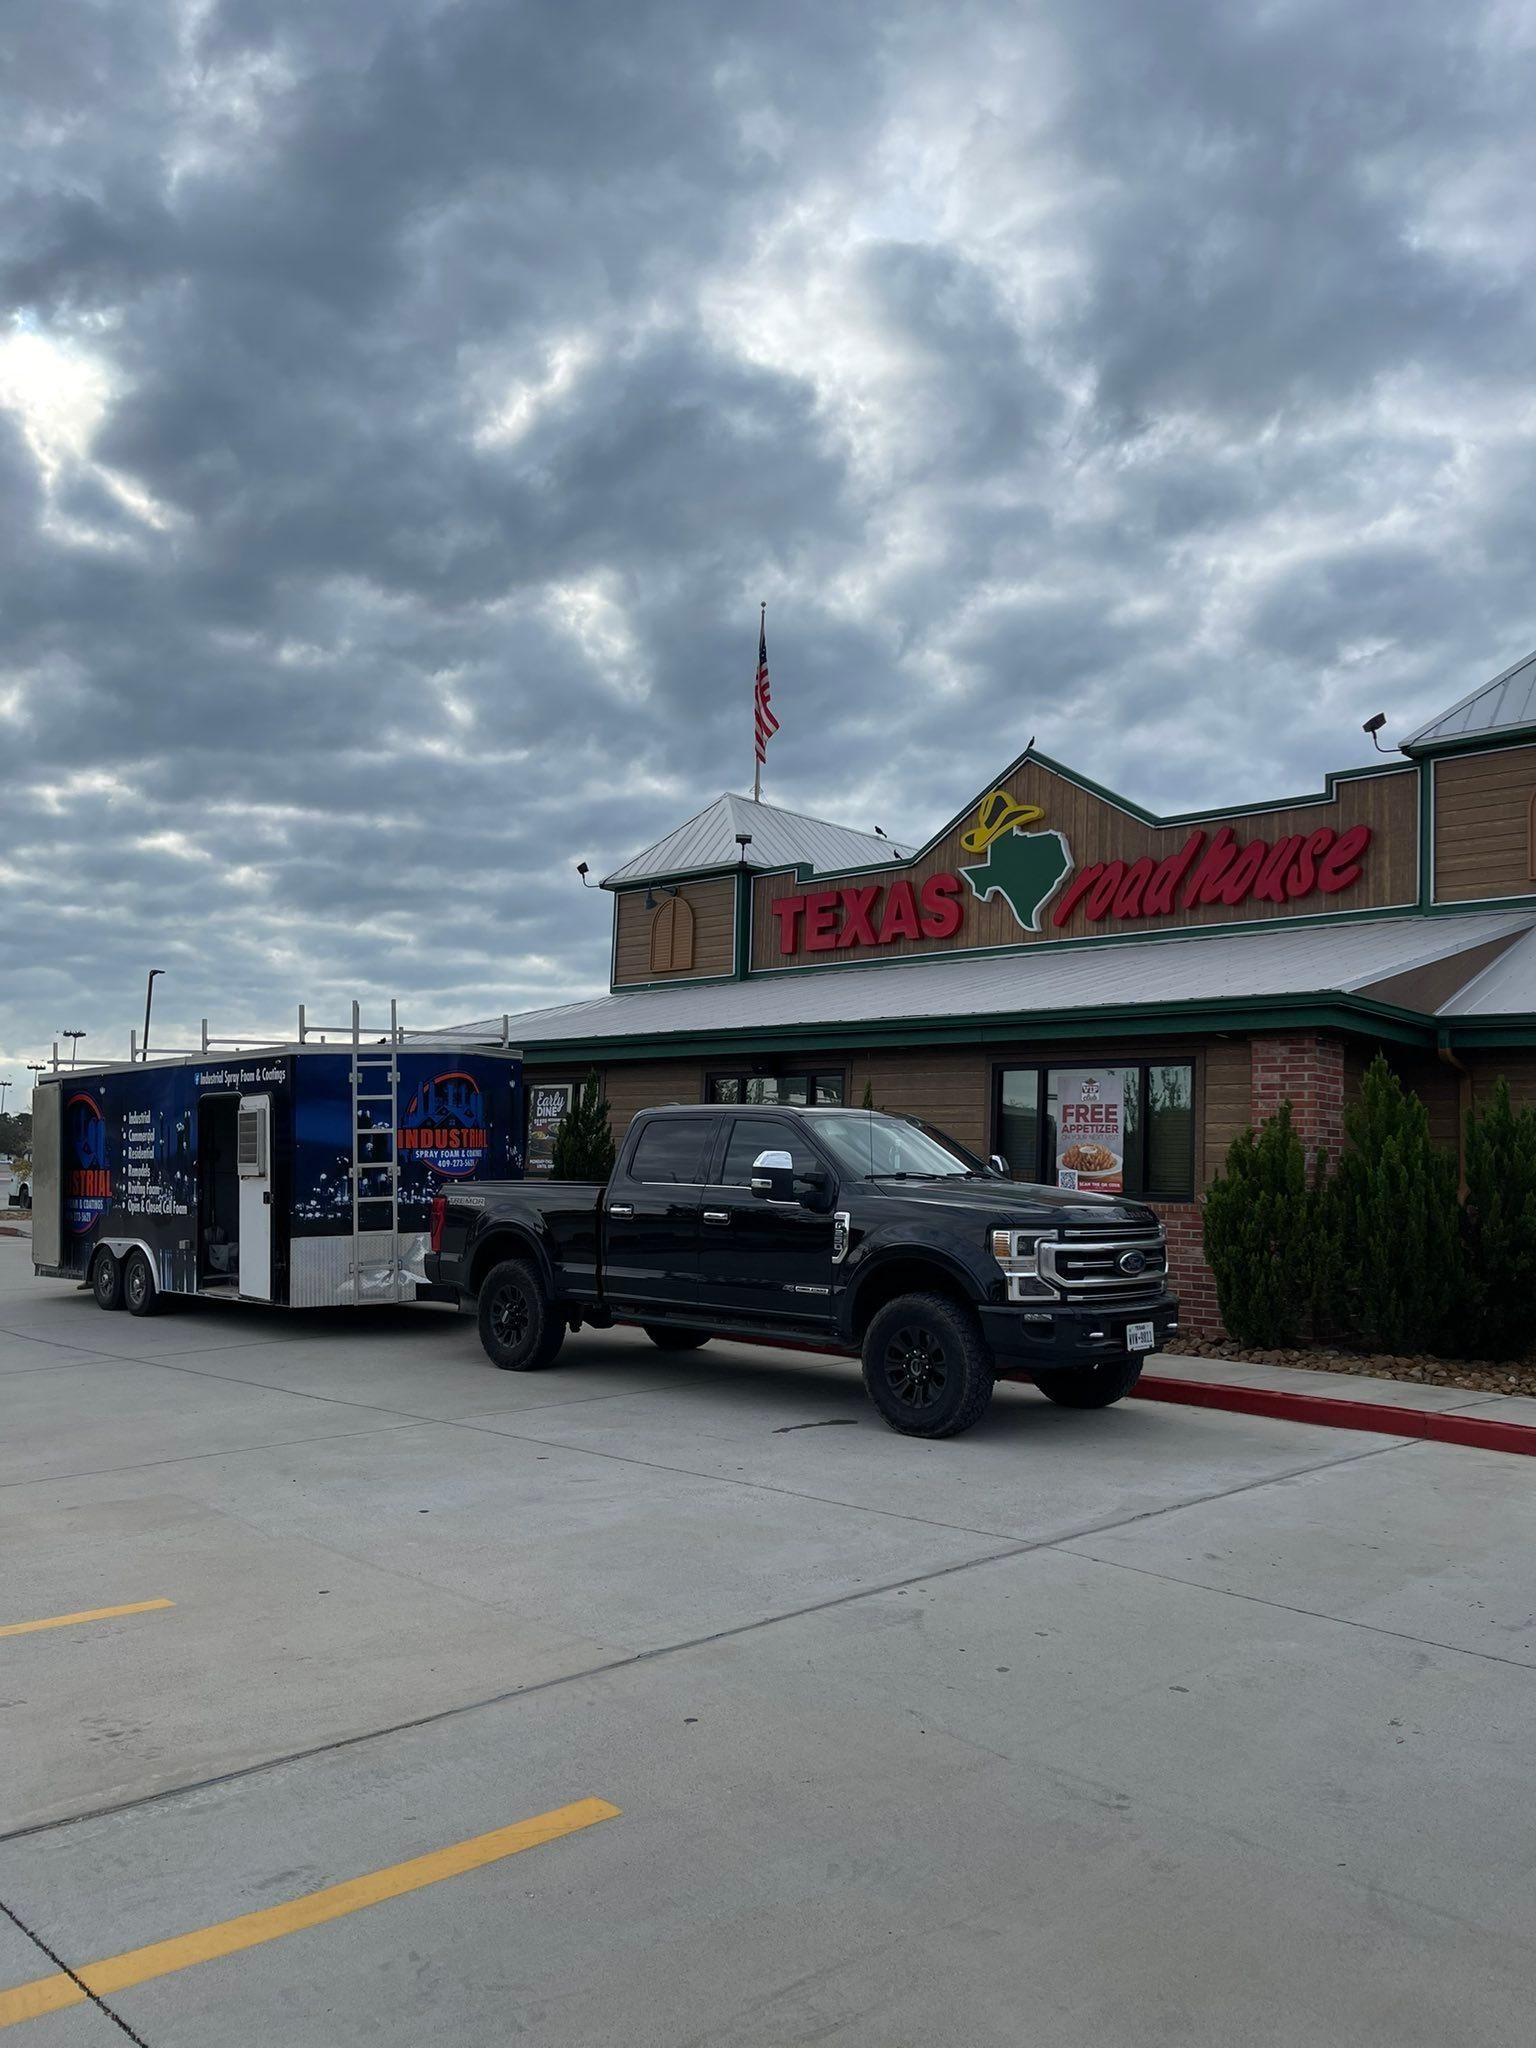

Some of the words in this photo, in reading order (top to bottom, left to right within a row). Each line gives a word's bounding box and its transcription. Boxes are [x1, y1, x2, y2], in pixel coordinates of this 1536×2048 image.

[772, 872, 962, 954] TEXAS
[200, 1070, 223, 1085] Industrial
[224, 1070, 239, 1090] Spray
[240, 1069, 254, 1082] Foam
[256, 1068, 261, 1081] &
[262, 1067, 285, 1084] Coatings
[537, 1091, 565, 1112] Early
[128, 1110, 151, 1124] Industrial
[1062, 1104, 1118, 1123] FREE
[128, 1128, 155, 1142] Commercial
[1061, 1124, 1119, 1133] APPETIZER
[397, 1128, 488, 1149] INDUSTRIAL
[128, 1145, 154, 1159] Residential
[415, 1150, 439, 1159] SPRAY
[441, 1149, 460, 1158] FOAM
[128, 1163, 151, 1177] Remodels
[127, 1181, 146, 1198] Roofing
[146, 1182, 160, 1194] Foam
[127, 1199, 141, 1215] Open
[141, 1200, 145, 1213] &
[145, 1199, 162, 1213] Closed
[162, 1200, 173, 1214] Cell
[173, 1201, 187, 1215] Foam
